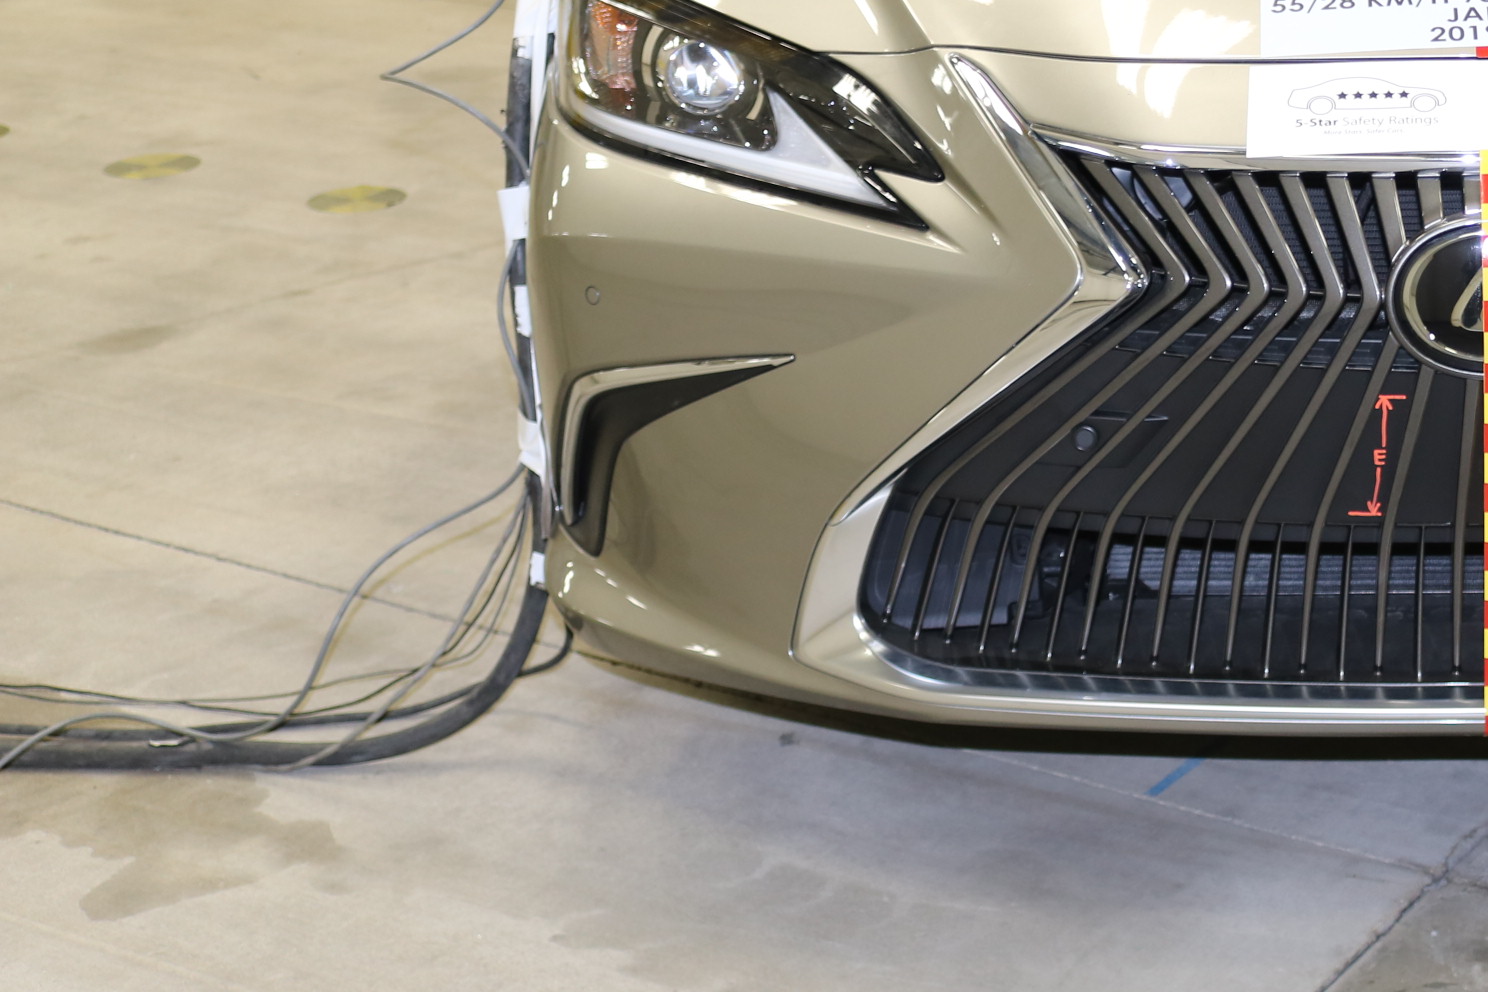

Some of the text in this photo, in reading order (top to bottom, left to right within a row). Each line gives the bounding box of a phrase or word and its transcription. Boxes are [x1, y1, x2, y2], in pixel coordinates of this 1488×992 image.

[1296, 116, 1439, 128] 5-Star Safety Ratings
[1373, 449, 1386, 466] E
